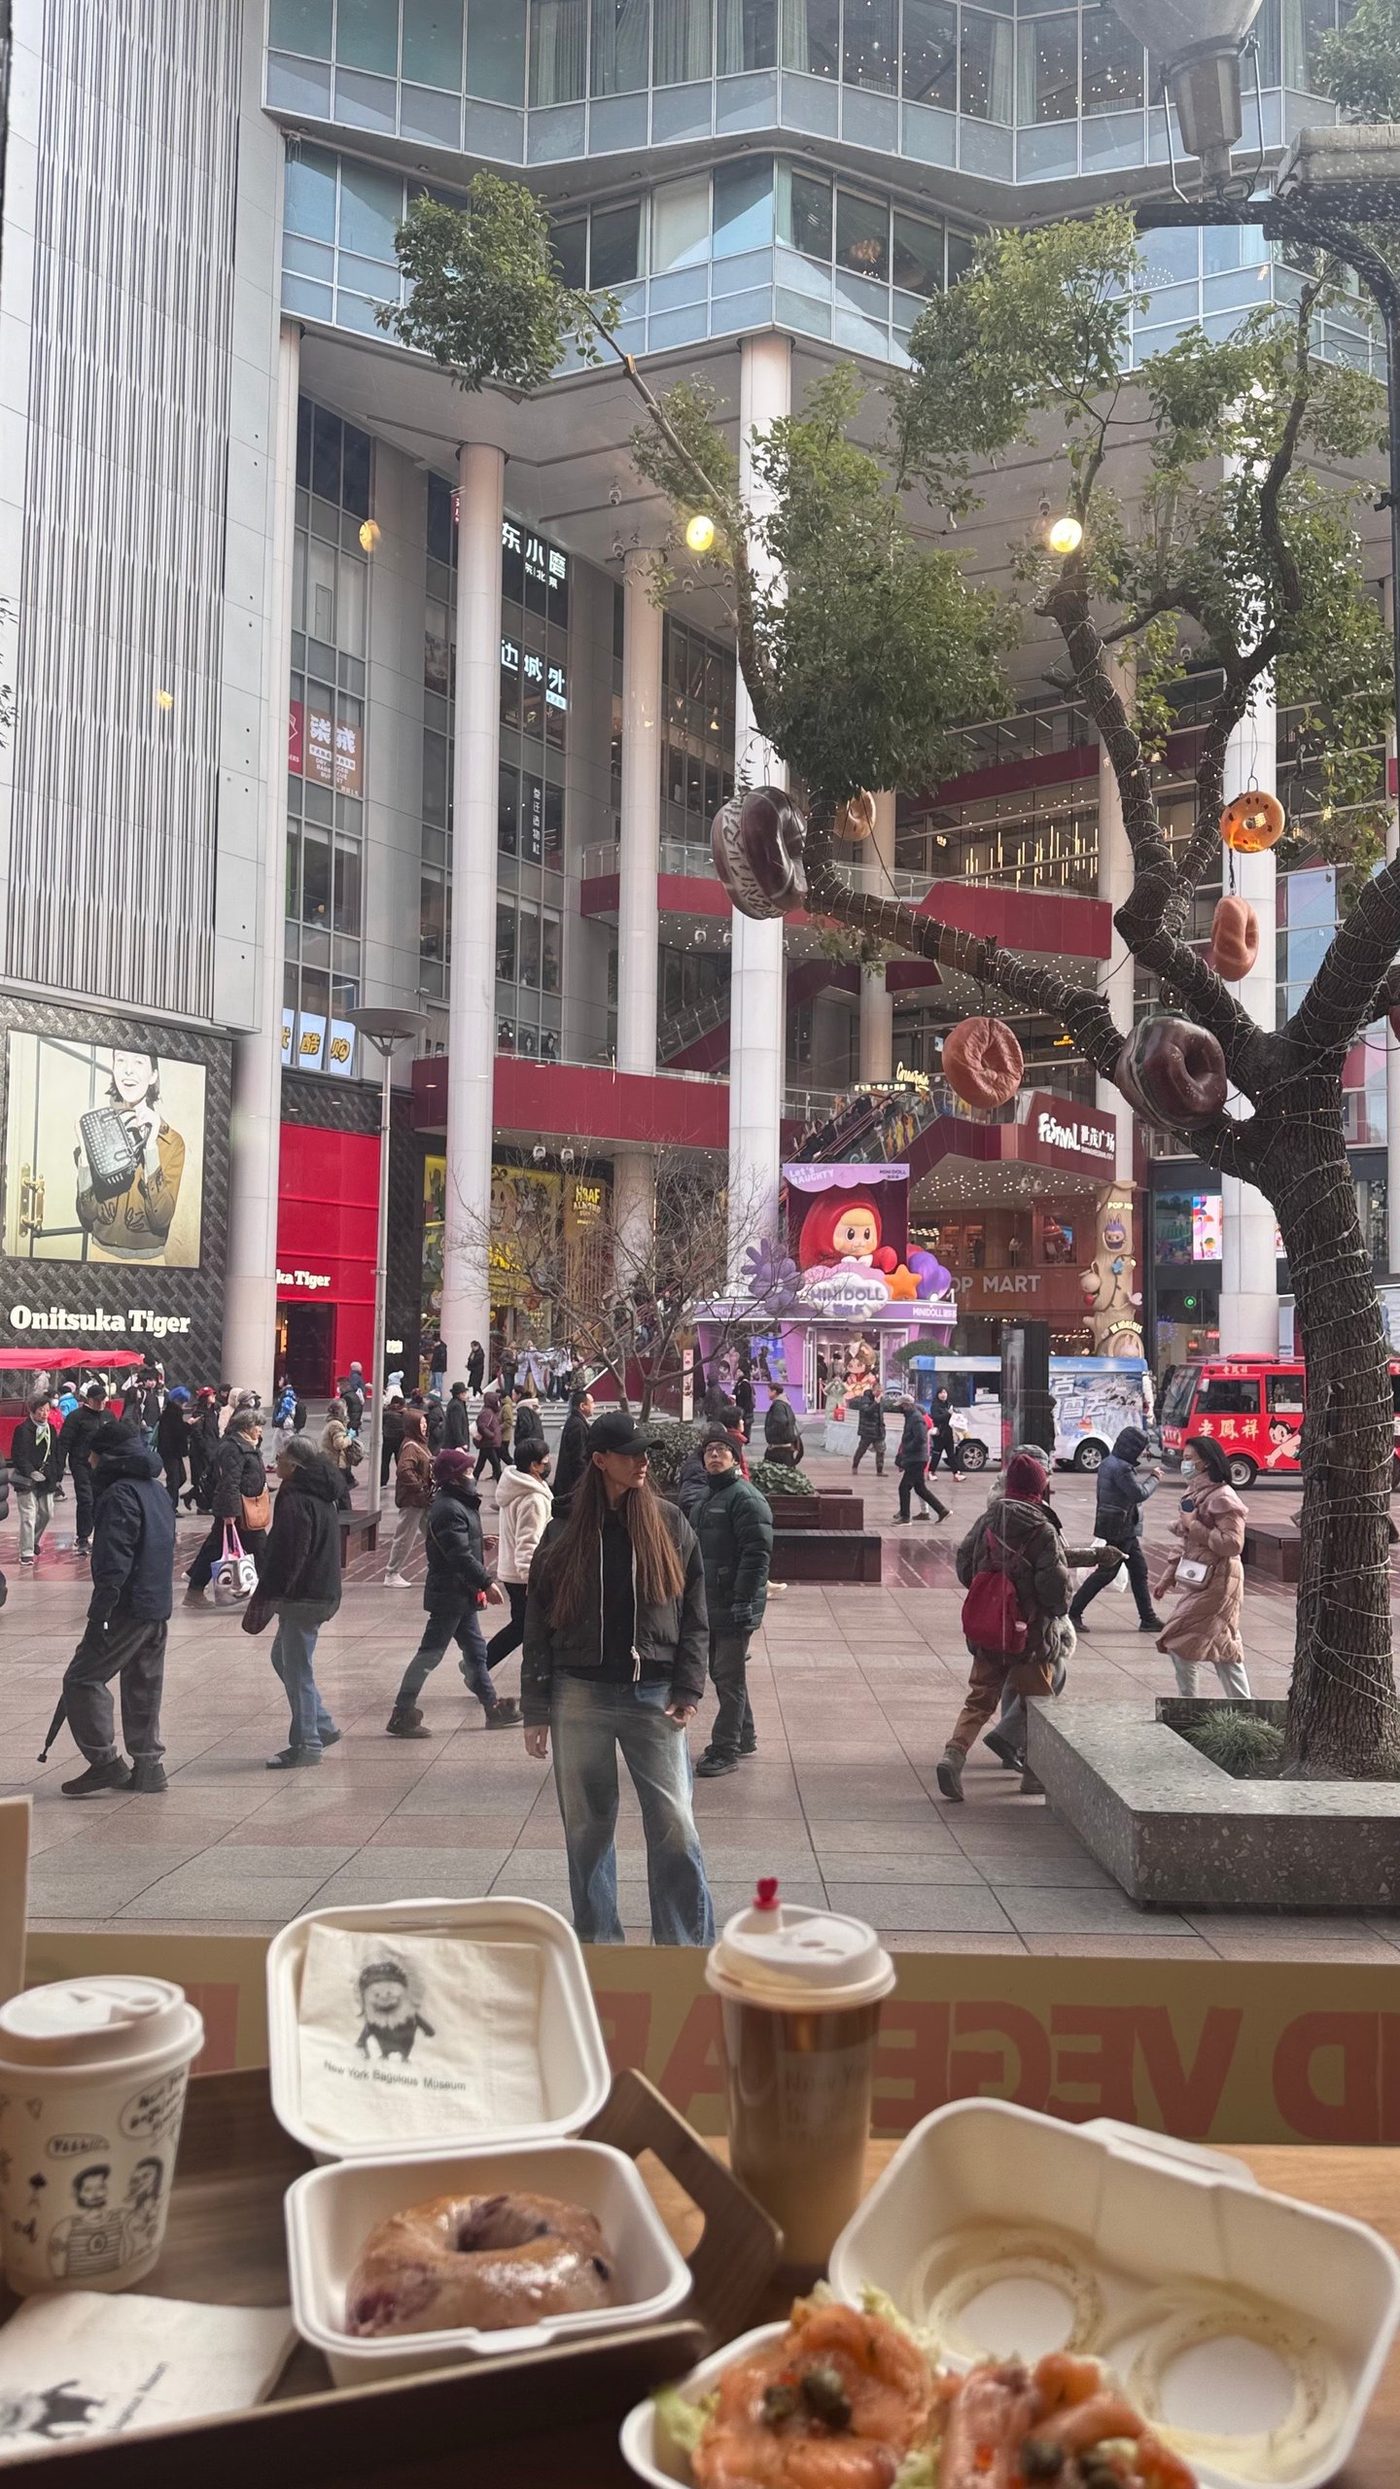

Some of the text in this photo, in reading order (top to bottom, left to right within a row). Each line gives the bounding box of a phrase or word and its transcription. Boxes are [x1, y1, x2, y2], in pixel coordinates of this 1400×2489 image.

[501, 639, 566, 693] 边城外
[1038, 1112, 1080, 1151] FESTIVAL
[1081, 1124, 1115, 1153] 世茂广场
[1107, 1202, 1124, 1210] POP
[294, 1270, 331, 1289] Tiger
[983, 1275, 1041, 1293] MART
[9, 1305, 191, 1338] Onitsuka Tiger
[1198, 1419, 1259, 1441] 老鳳祥
[324, 2059, 345, 2074] New
[348, 2066, 369, 2081] York
[423, 2077, 466, 2091] Museum
